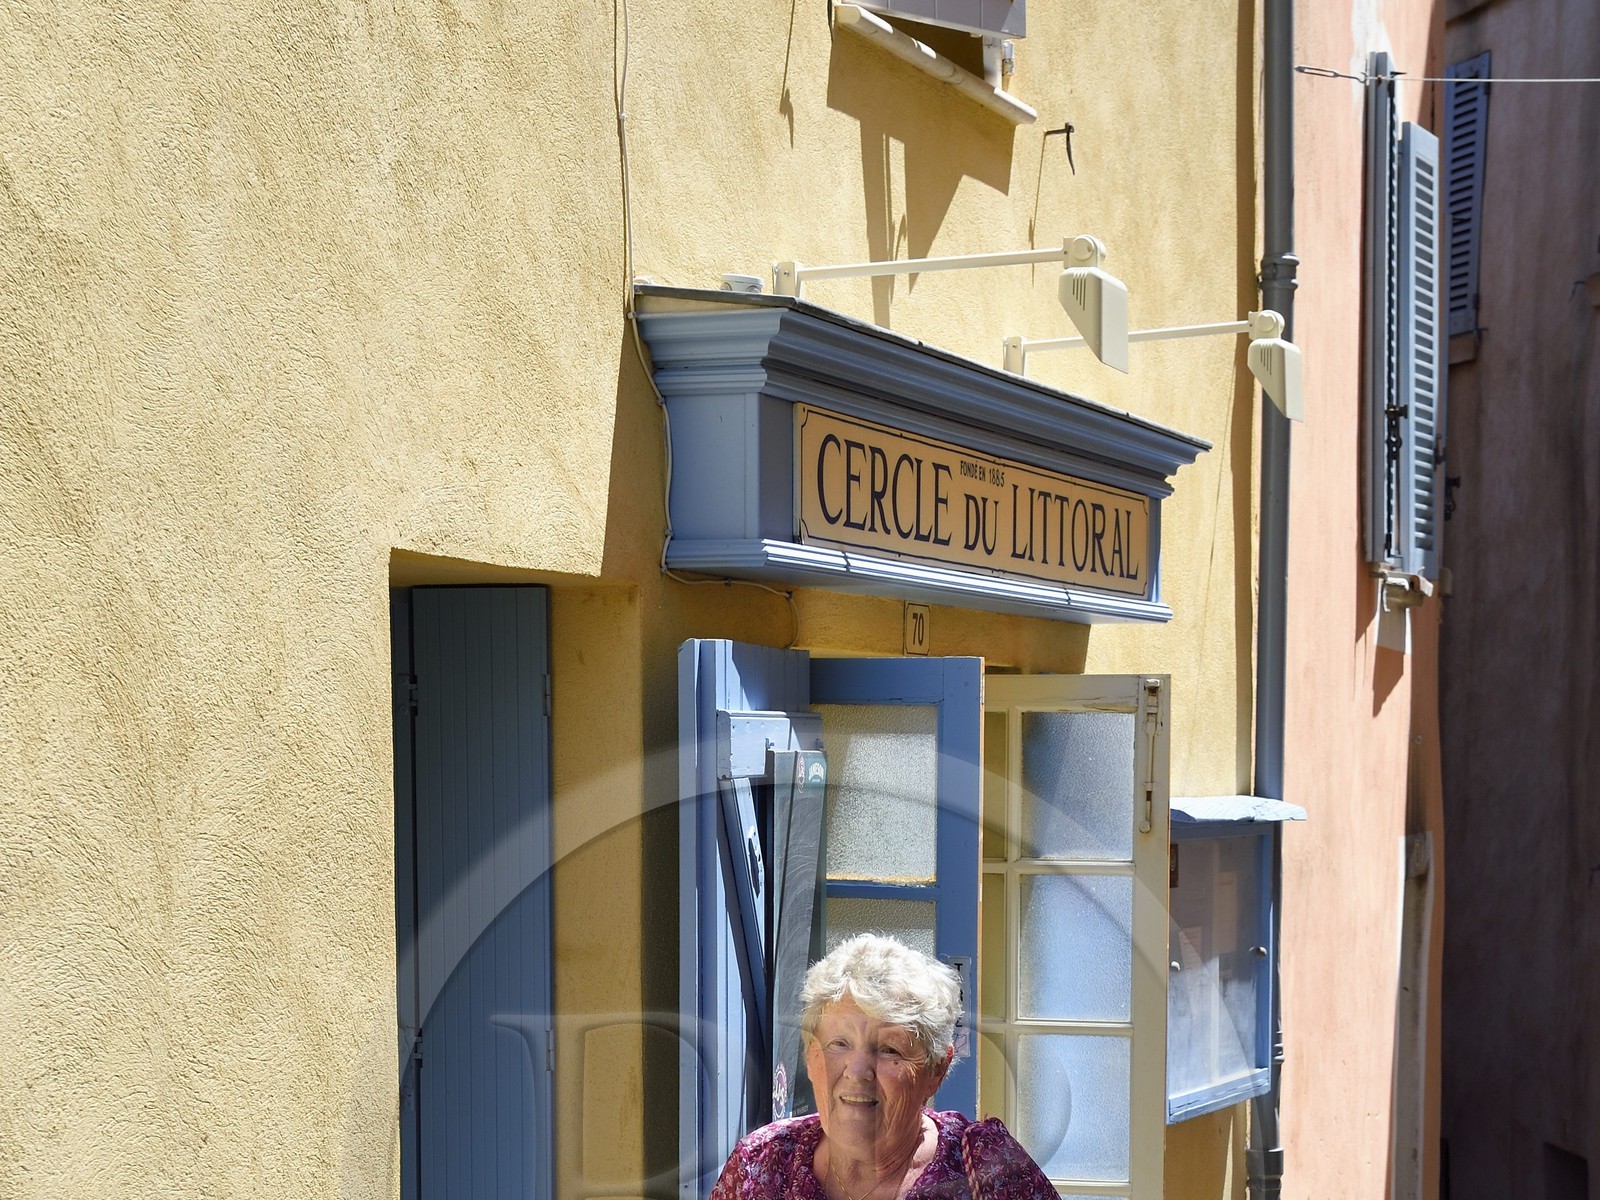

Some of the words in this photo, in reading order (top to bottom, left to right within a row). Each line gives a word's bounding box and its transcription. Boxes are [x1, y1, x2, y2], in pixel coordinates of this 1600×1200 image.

[960, 460, 978, 480] FONDÉ
[979, 466, 986, 482] EN
[989, 468, 1005, 487] 1885
[817, 433, 953, 546] CERCLE
[964, 493, 999, 556] DU
[1010, 484, 1139, 580] LITTORAL
[912, 612, 925, 647] 70
